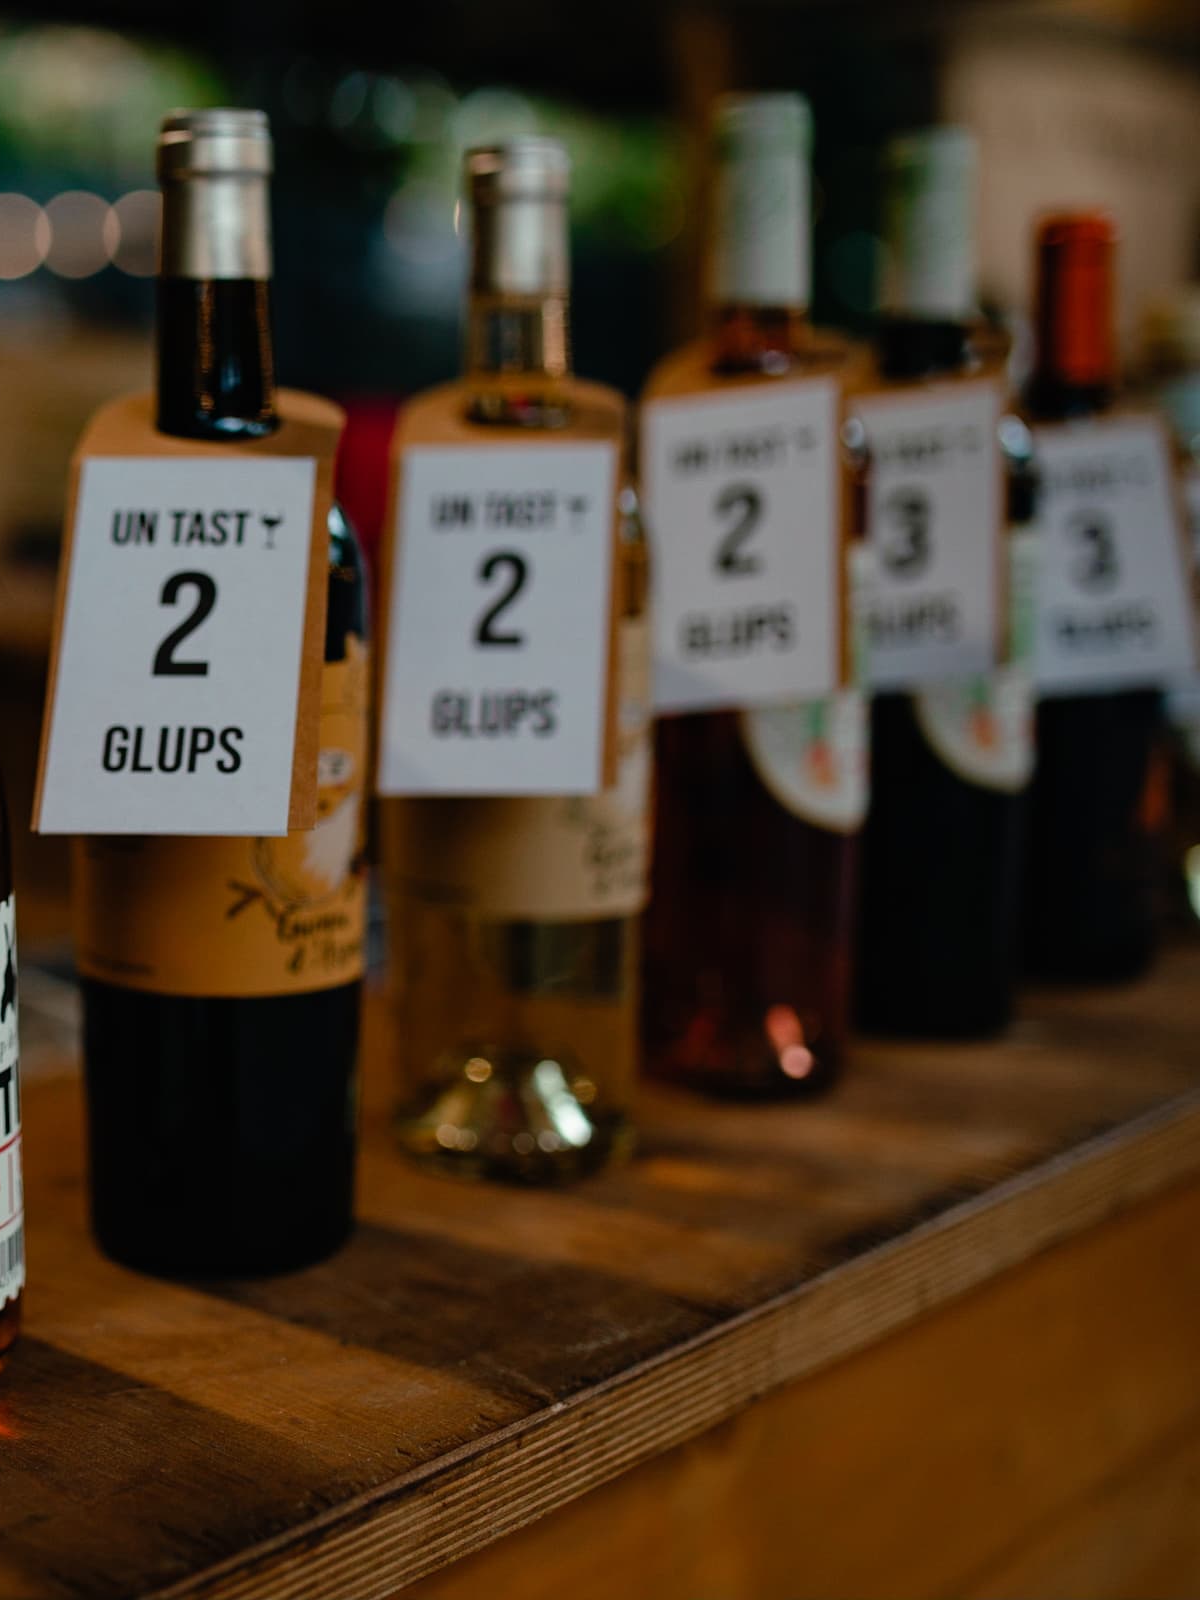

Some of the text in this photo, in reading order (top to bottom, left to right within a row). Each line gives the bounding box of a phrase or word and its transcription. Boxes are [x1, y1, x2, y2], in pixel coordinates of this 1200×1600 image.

[111, 510, 252, 547] UN TAST
[432, 496, 476, 532] UN
[714, 483, 764, 579] 2
[883, 486, 933, 580] 3
[151, 571, 218, 678] 2
[475, 548, 529, 649] 2
[430, 689, 557, 738] GLUPS
[102, 726, 245, 774] GLUPS
